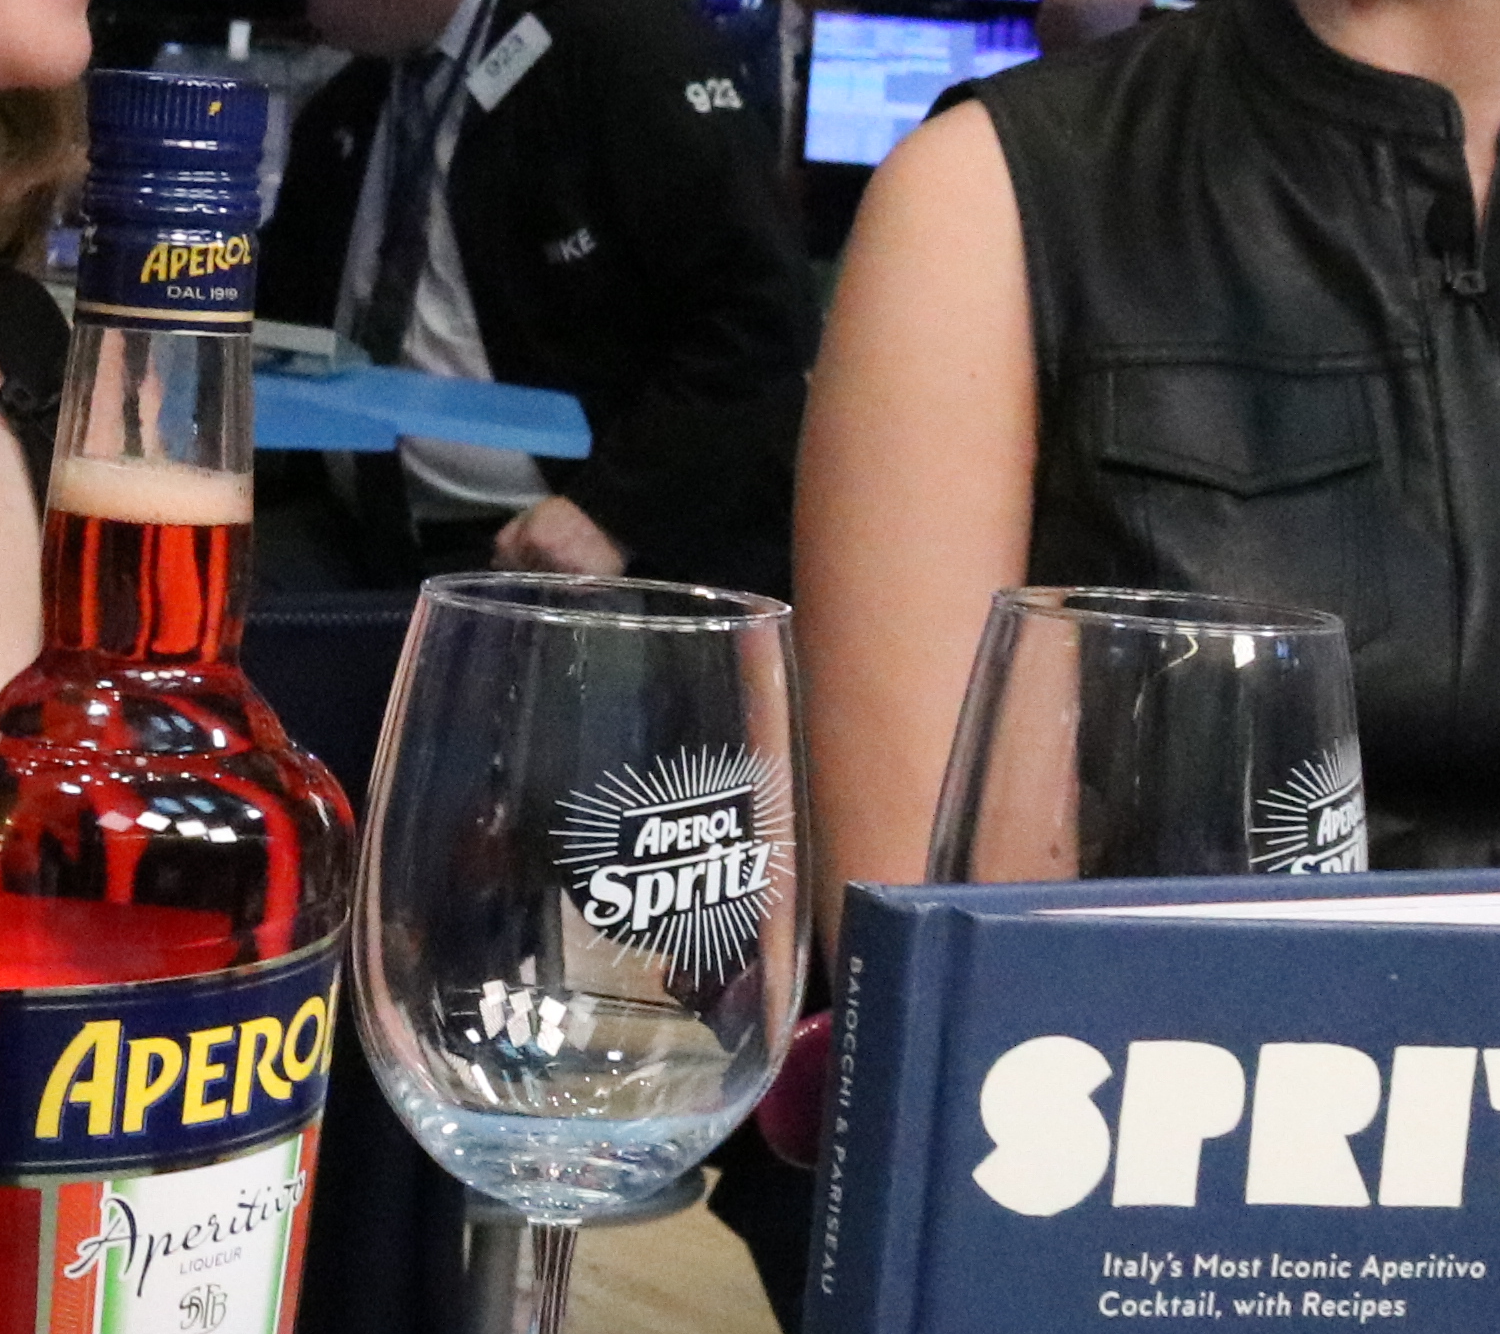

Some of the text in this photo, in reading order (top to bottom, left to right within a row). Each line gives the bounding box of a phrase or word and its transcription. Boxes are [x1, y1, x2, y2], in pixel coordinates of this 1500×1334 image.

[140, 233, 252, 284] APEROL
[166, 285, 207, 301] DAL
[633, 805, 744, 858] APEROL
[582, 840, 774, 933] Spritz
[838, 955, 864, 1108] BAIOCCHI
[820, 1144, 848, 1297] PARISEAU
[179, 1246, 243, 1275] LIQUEUR
[1102, 1252, 1488, 1286] Italy's Most Iconic Aperitivo
[1099, 1291, 1407, 1325] Cocktail, with Recipes
